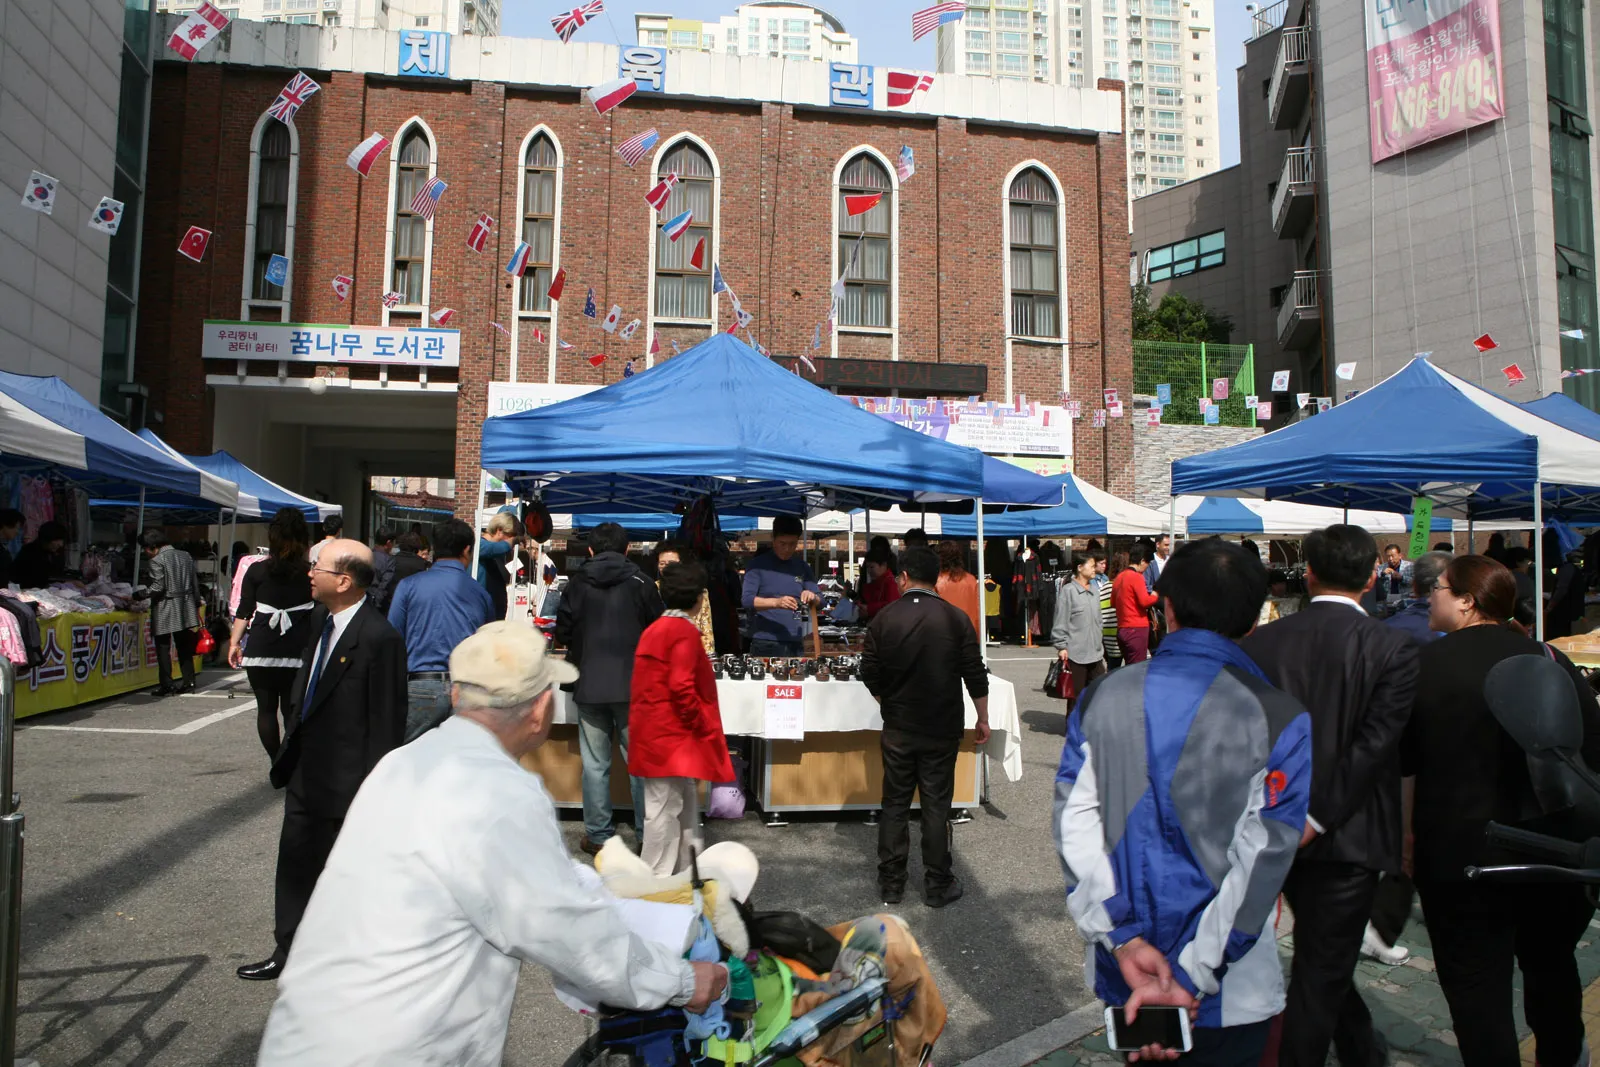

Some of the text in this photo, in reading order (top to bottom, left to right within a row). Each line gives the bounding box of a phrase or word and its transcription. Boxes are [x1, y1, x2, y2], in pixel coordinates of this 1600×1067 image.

[402, 32, 447, 75] 체
[831, 64, 873, 108] 관
[217, 329, 259, 342] 우리동네
[228, 342, 252, 353] 꿈터!
[290, 331, 446, 360] 꿈나무 도서관
[774, 688, 796, 697] SALE
